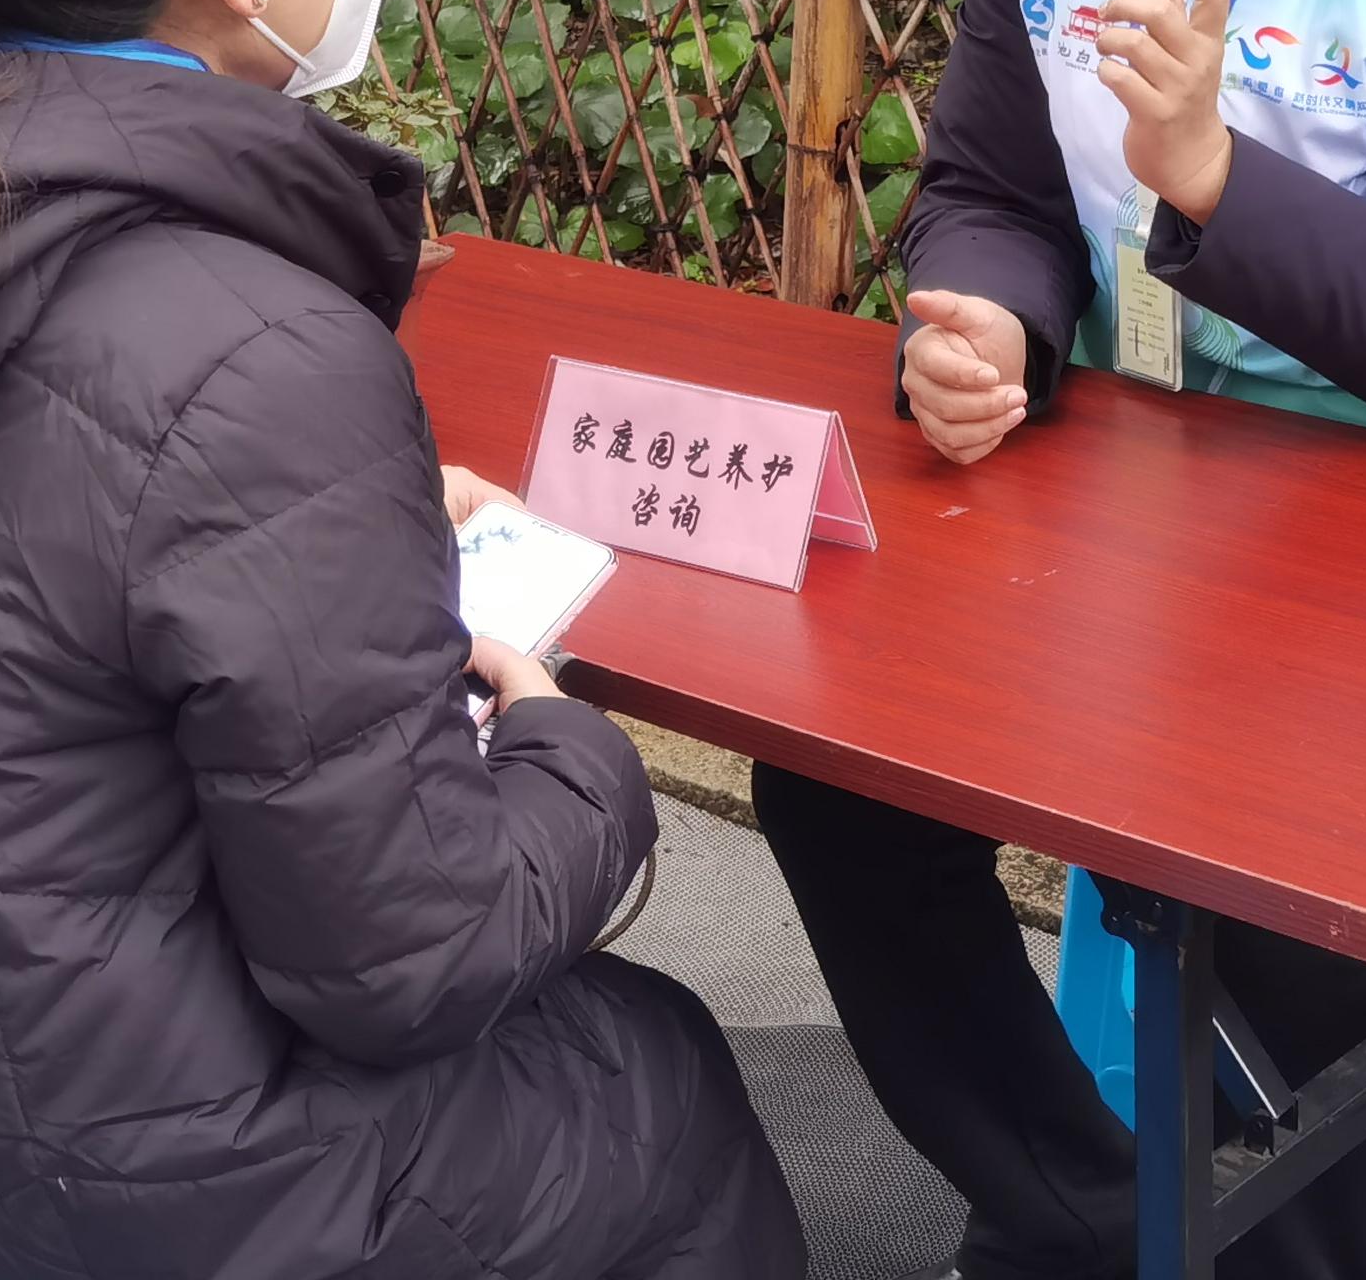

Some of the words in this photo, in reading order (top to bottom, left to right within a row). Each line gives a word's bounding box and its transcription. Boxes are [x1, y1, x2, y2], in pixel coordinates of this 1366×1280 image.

[571, 411, 795, 493] 家庭园艺养护
[630, 483, 701, 537] 咨询
